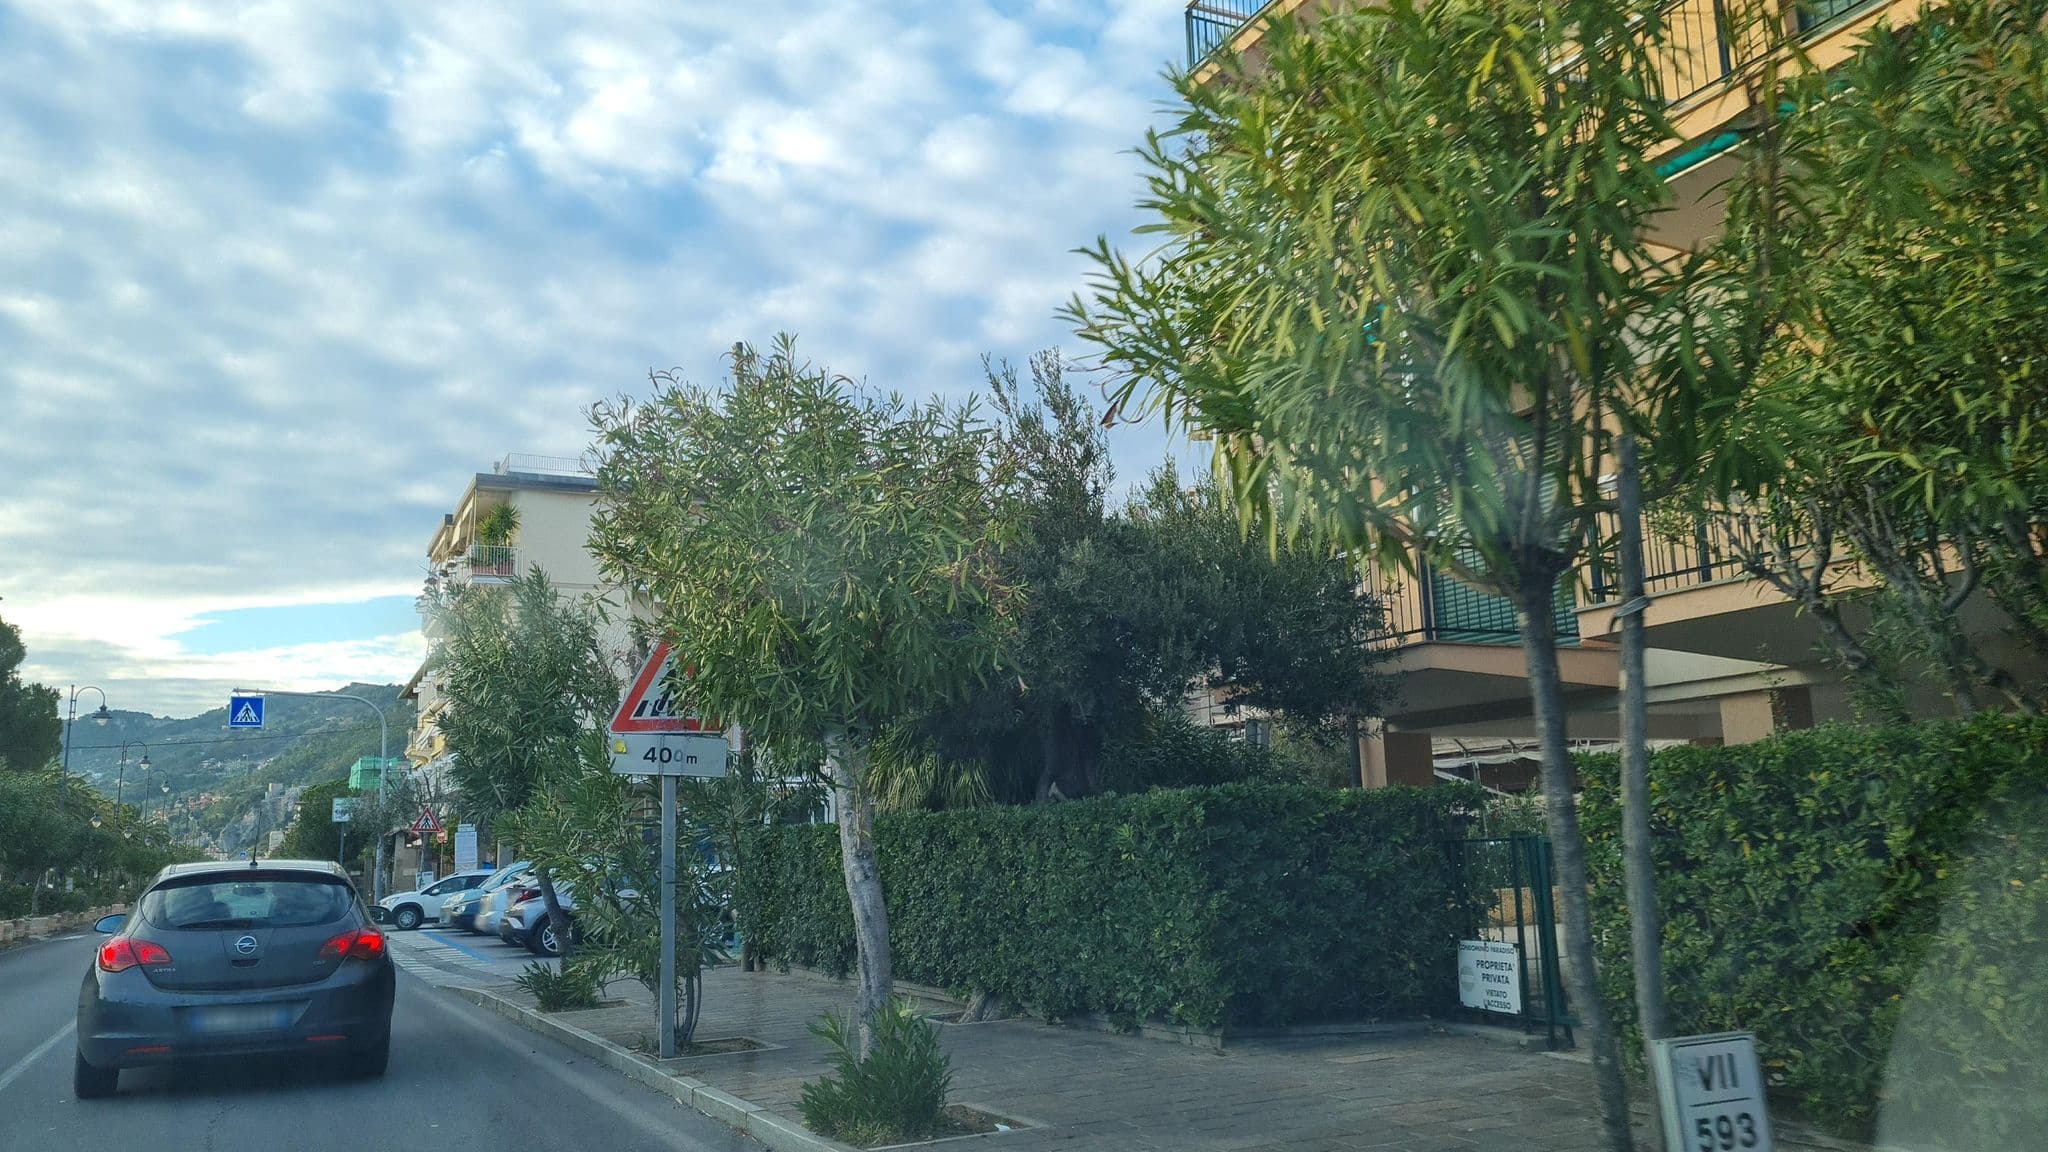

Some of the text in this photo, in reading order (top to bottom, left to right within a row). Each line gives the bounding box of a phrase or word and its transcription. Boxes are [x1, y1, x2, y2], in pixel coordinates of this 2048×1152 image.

[1482, 973, 1510, 985] PRIVATA
[1486, 989, 1507, 999] VIETATO
[1696, 1052, 1739, 1092] VII
[1694, 1112, 1759, 1152] 593
